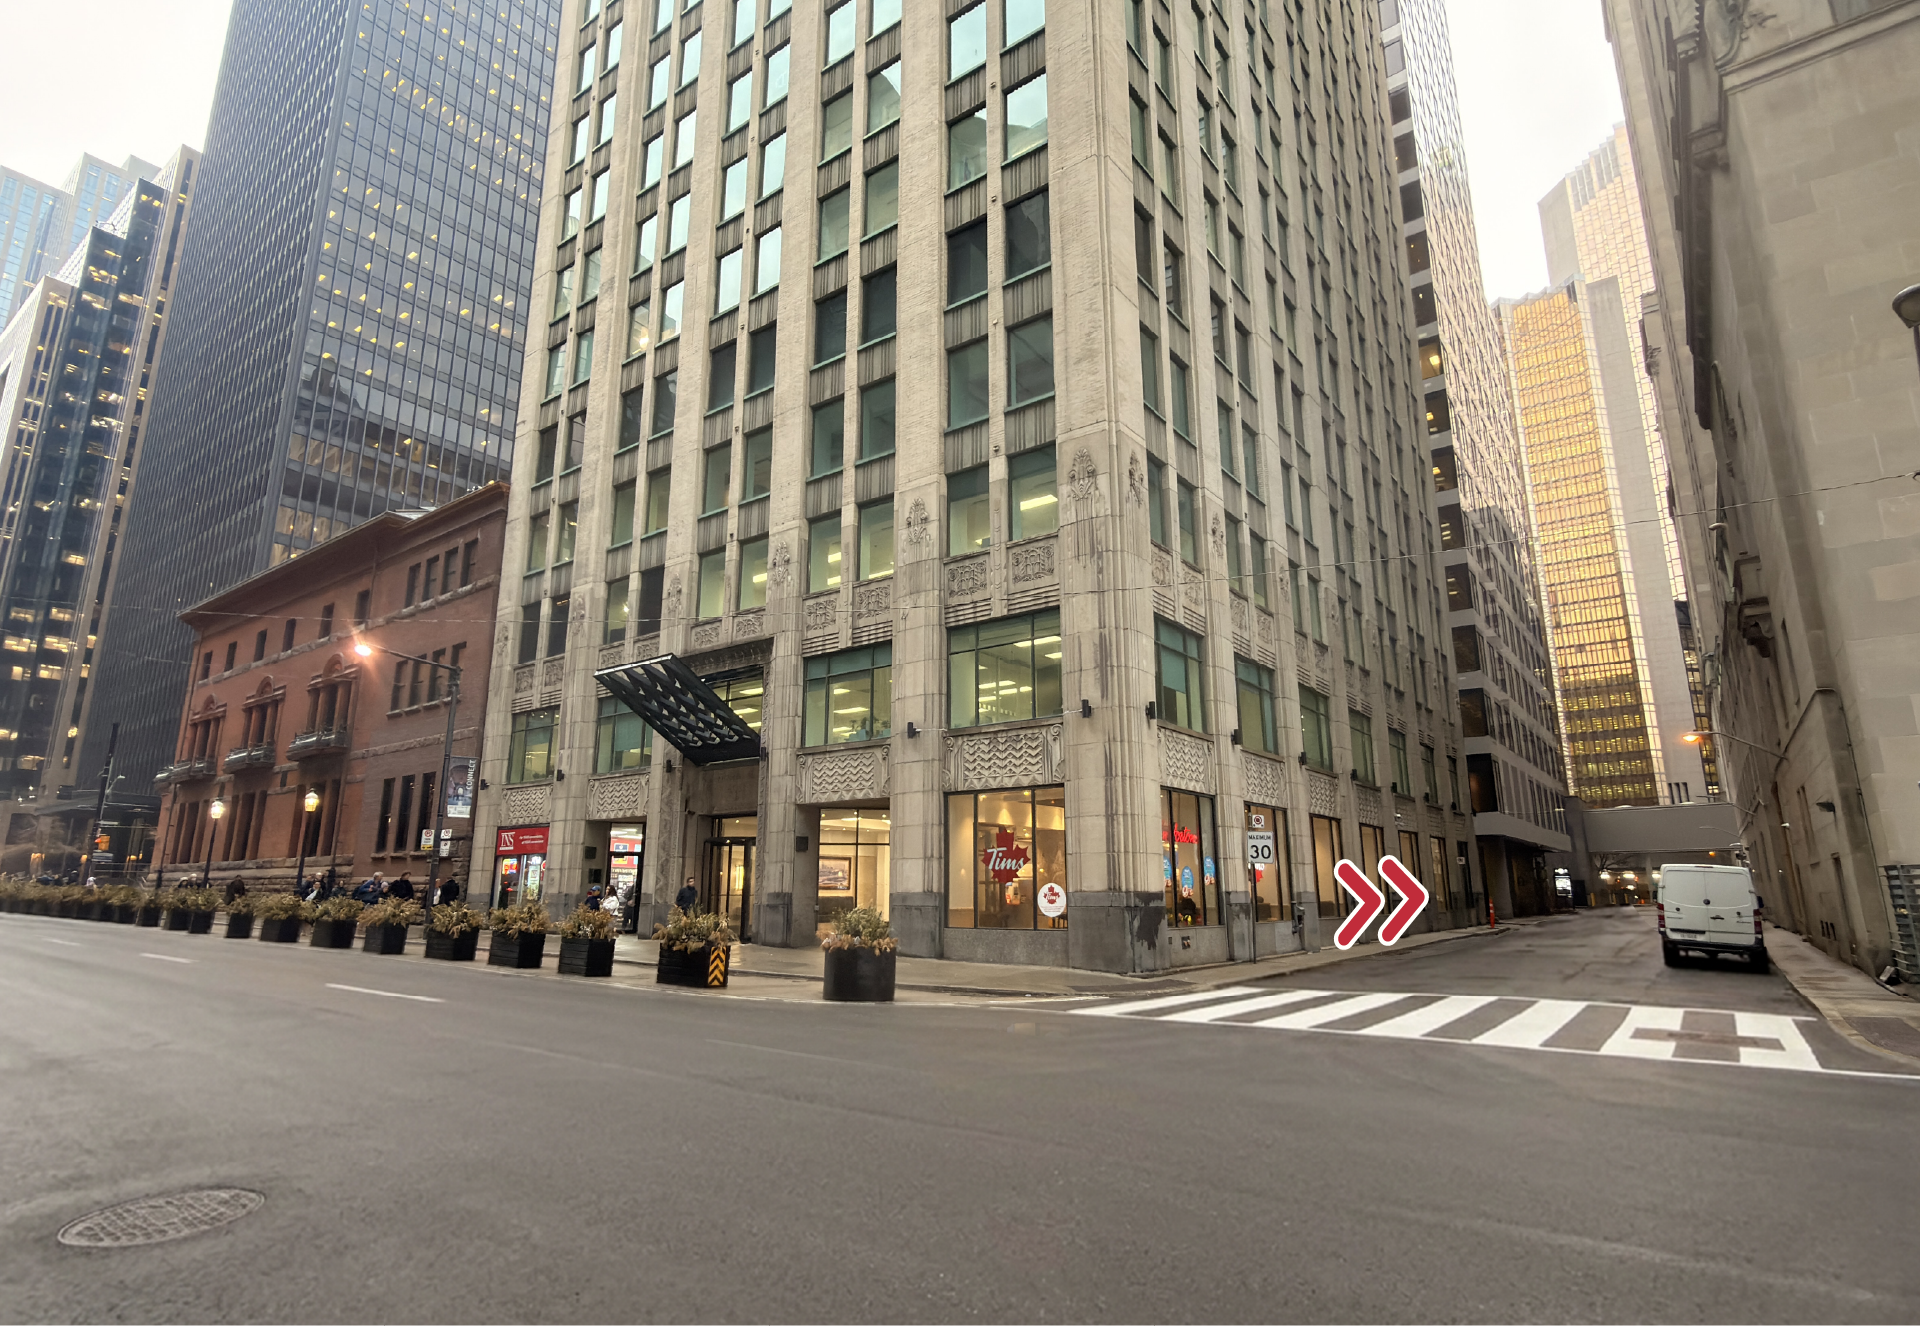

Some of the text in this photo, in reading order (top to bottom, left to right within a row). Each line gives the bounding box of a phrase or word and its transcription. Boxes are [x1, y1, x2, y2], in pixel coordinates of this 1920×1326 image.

[465, 759, 477, 790] CONNECT
[986, 847, 1025, 870] Tims
[1249, 844, 1272, 859] 30
